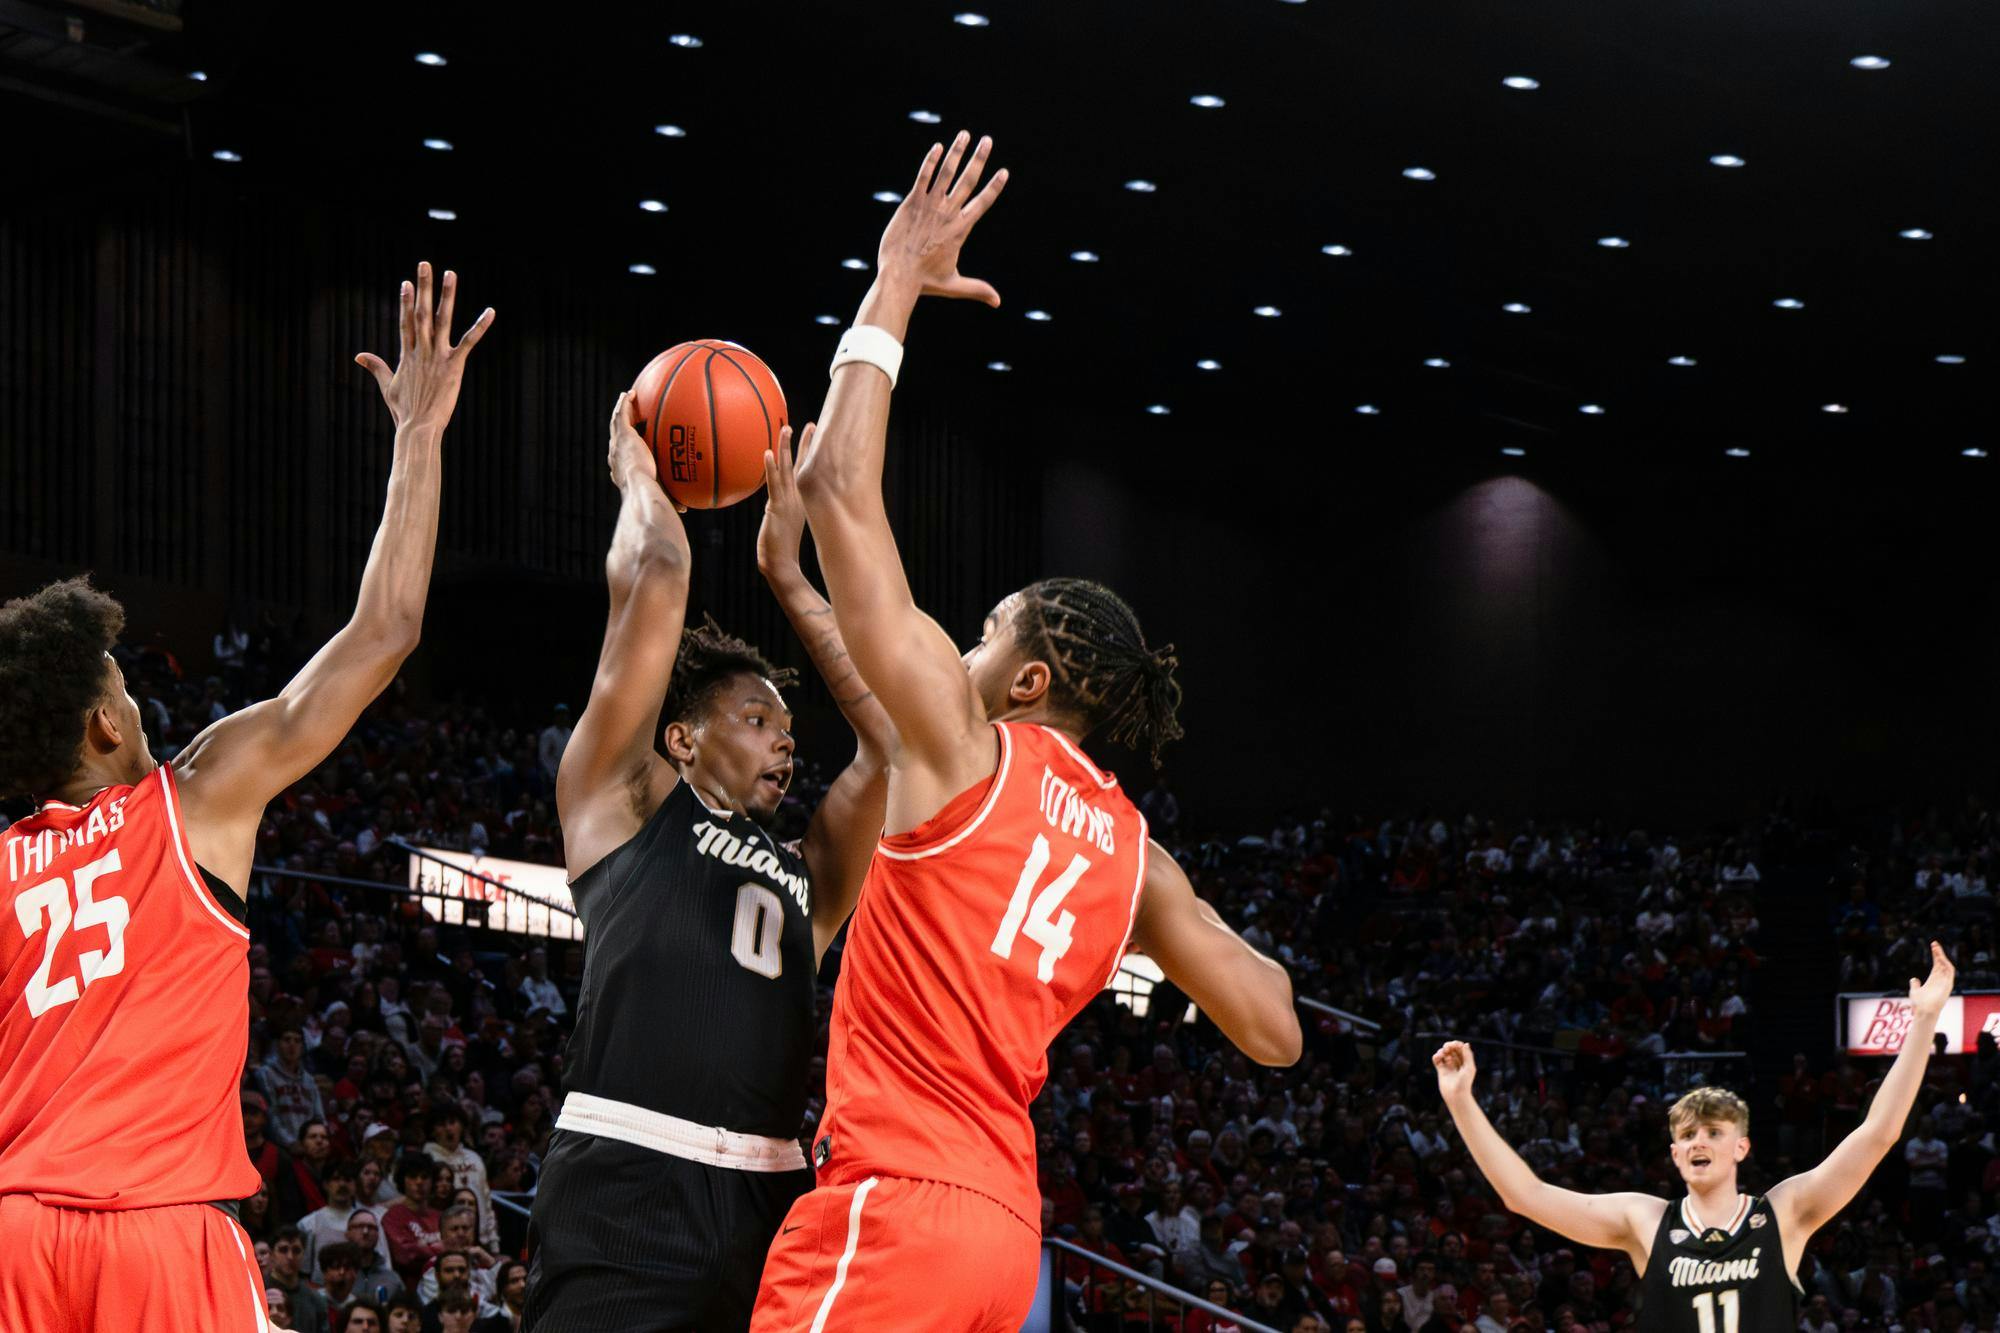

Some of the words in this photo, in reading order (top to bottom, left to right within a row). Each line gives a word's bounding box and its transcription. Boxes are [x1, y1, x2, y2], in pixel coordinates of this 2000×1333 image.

[670, 425, 688, 482] PRO
[1039, 764, 1115, 856] TOWNS
[692, 820, 809, 918] Miami
[990, 832, 1092, 985] 14
[14, 848, 130, 1019] 25
[730, 881, 785, 980] 0
[1668, 1246, 1762, 1287] Miami
[1691, 1289, 1740, 1333] 11
